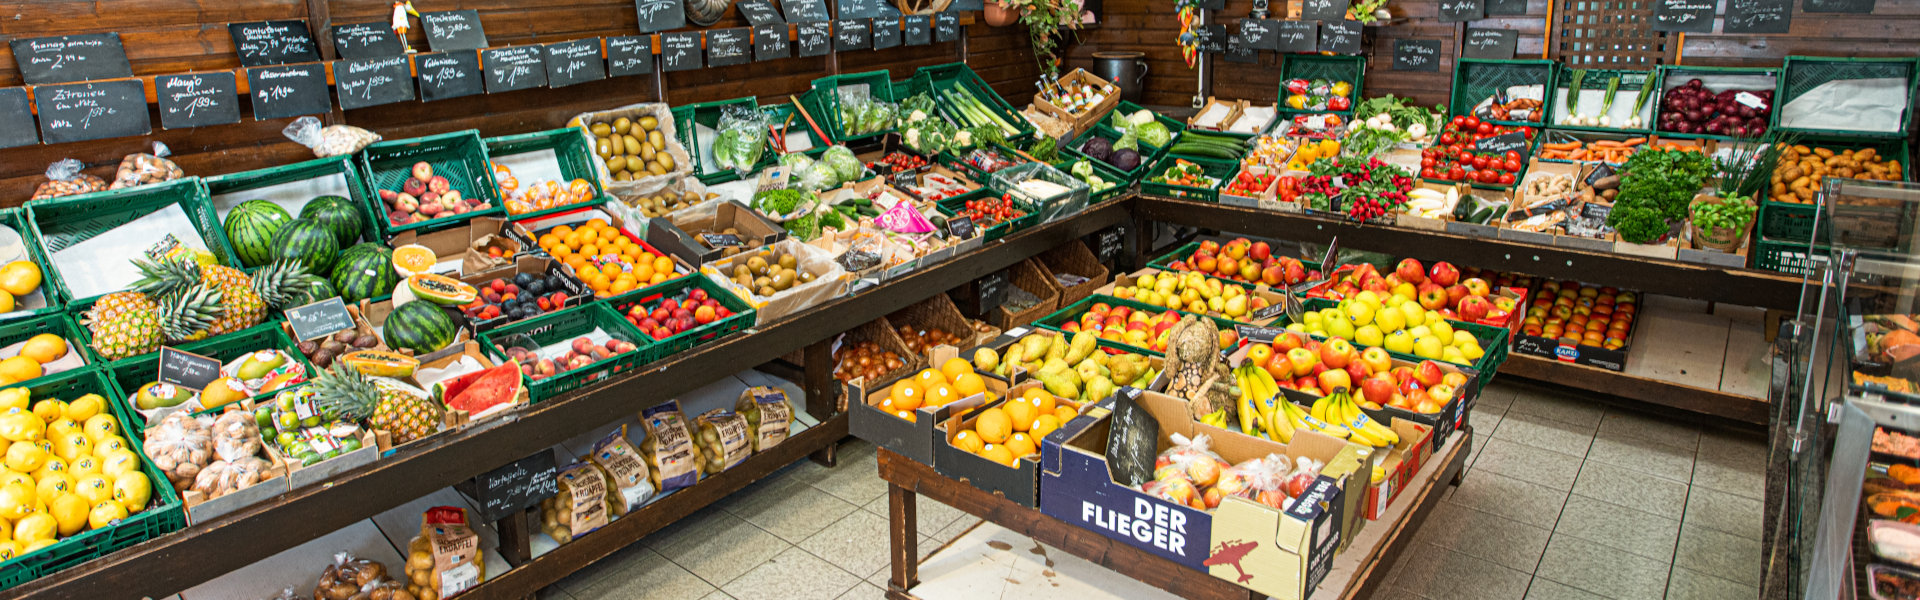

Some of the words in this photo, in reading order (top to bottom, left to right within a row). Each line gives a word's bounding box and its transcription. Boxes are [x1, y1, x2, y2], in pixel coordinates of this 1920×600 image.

[551, 268, 580, 294] CONQUET
[1082, 500, 1186, 556] FLIEGER
[1134, 497, 1187, 534] DER
